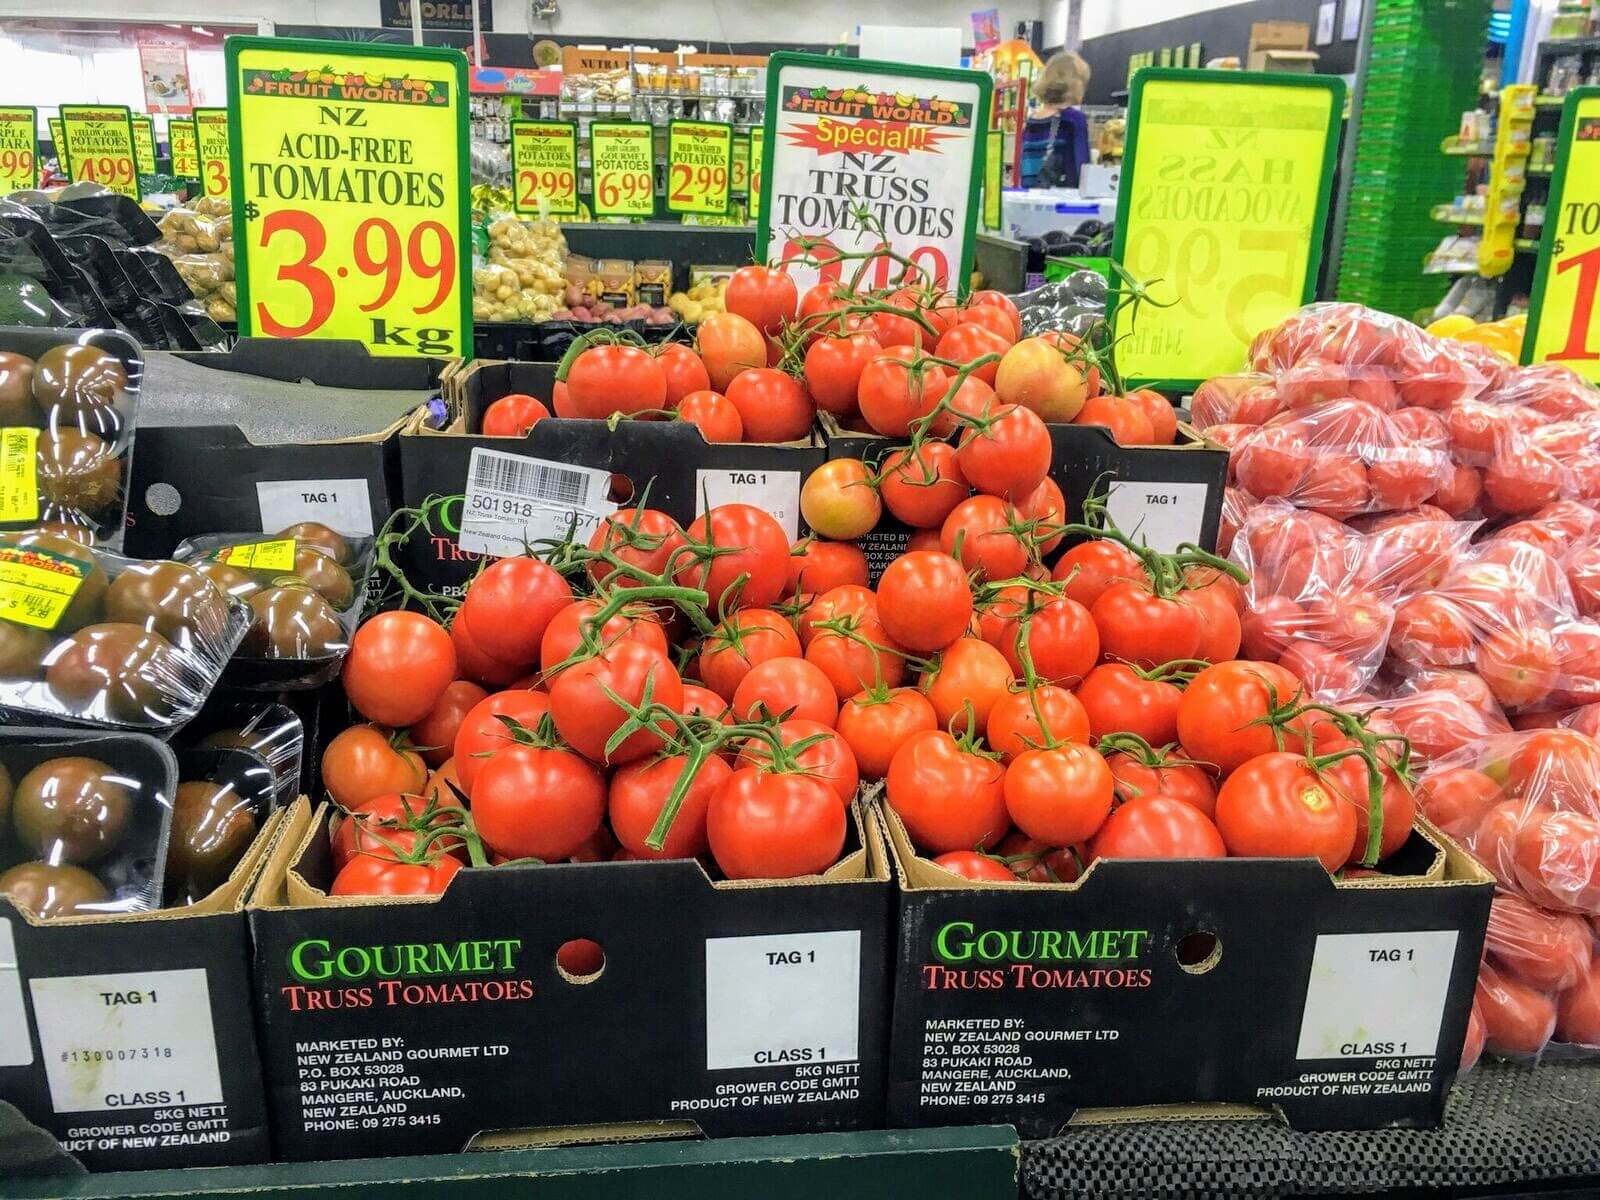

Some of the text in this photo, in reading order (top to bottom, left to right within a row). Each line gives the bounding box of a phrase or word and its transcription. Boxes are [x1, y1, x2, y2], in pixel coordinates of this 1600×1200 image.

[264, 81, 429, 104] FRUIT WORLD
[318, 106, 368, 127] NZ
[801, 98, 953, 125] FRUIT WORLD
[71, 135, 128, 146] POTATOES
[278, 132, 413, 165] ACID-FREE
[678, 143, 692, 152] RED
[518, 151, 571, 161] POTATOES
[601, 152, 646, 160] GOURMET
[673, 152, 726, 166] POTATOES
[840, 152, 897, 174] NZ
[596, 159, 649, 171] POTATOES
[250, 162, 445, 208] TOMATOES
[808, 169, 929, 204] TRUSS
[705, 196, 724, 209] kg
[369, 318, 454, 355] kg
[729, 473, 767, 485] TAG 1
[301, 492, 338, 503] TAG 1
[1145, 494, 1178, 505] TAG 1
[936, 921, 1149, 961] GOURMET
[290, 939, 522, 981] GOURMET
[765, 950, 816, 966] TAG 1
[1368, 949, 1415, 962] TAG 1
[922, 964, 1152, 990] TRUSS TOMATOES
[100, 990, 158, 1006] TAG 1
[281, 979, 534, 1011] TRUSS TOMATOES
[926, 1018, 1025, 1030] MARKETED BY:
[924, 1030, 1120, 1043] NEW ZEALAND GOURMET LTD
[296, 1037, 405, 1053] MARKETED BY:
[923, 1044, 1020, 1055] P.O. BOX 53028
[1340, 1041, 1407, 1056] CLASS 1
[297, 1045, 510, 1066] NEW ZEALAND GOURMET LTD
[753, 1048, 826, 1064] CLASS 1
[922, 1056, 1033, 1068] 83 PUKAKI ROAD
[1375, 1057, 1437, 1069] 5KG NETT
[299, 1063, 405, 1079] P.O. BOX 53028
[795, 1063, 861, 1077] 5KG NETT
[921, 1068, 1072, 1080] MANGERE, AUCKLAND,
[1299, 1070, 1434, 1084] GROWER CODE GMTT
[300, 1075, 420, 1092] 83 PUKAKI ROAD
[715, 1076, 861, 1096] GROWER CODE GMTT
[921, 1081, 1017, 1093] NEW ZEALAND
[1256, 1082, 1432, 1098] PRODUCT OF NEW ZEALAND
[105, 1090, 186, 1107] CLASS 1
[302, 1086, 466, 1106] MANGERE, AUCKLAND,
[671, 1089, 860, 1111] PRODUCT OF NEW ZEALAND
[920, 1093, 1046, 1106] PHONE: 09 275 3415
[154, 1105, 228, 1121] 5KG NETT
[303, 1103, 407, 1119] NEW ZEALAND
[67, 1118, 229, 1138] GROWER CODE GMTT
[304, 1114, 441, 1132] PHONE: 09 275 3415
[99, 1138, 120, 1151] OF
[122, 1135, 159, 1149] NEW
[160, 1131, 230, 1147] ZEALAND
